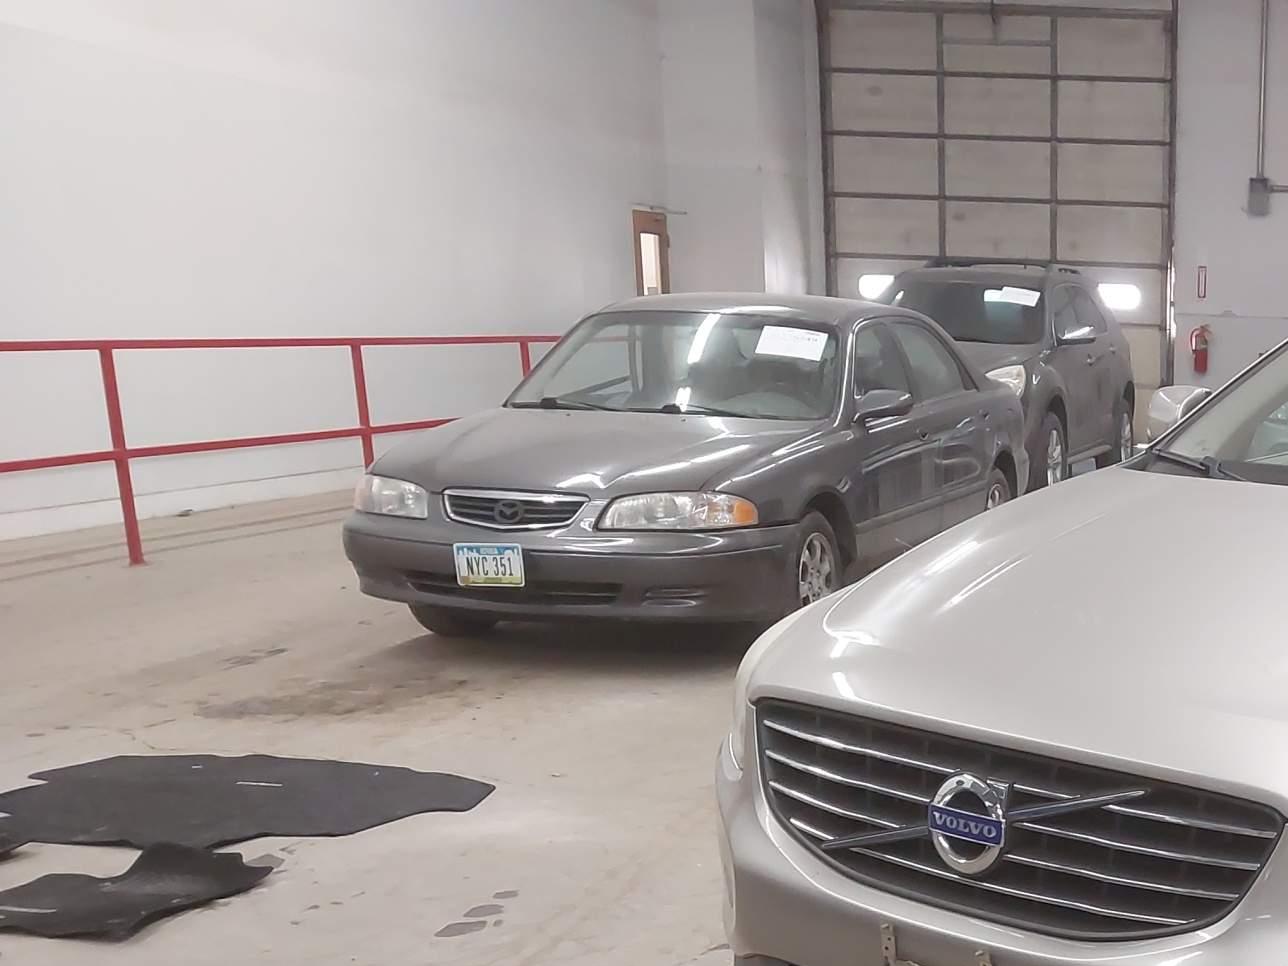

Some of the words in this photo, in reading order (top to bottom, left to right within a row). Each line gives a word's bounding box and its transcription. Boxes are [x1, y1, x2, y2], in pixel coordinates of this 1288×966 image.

[466, 556, 489, 577] NYC
[492, 556, 514, 577] 351
[932, 811, 997, 838] VOLVO
